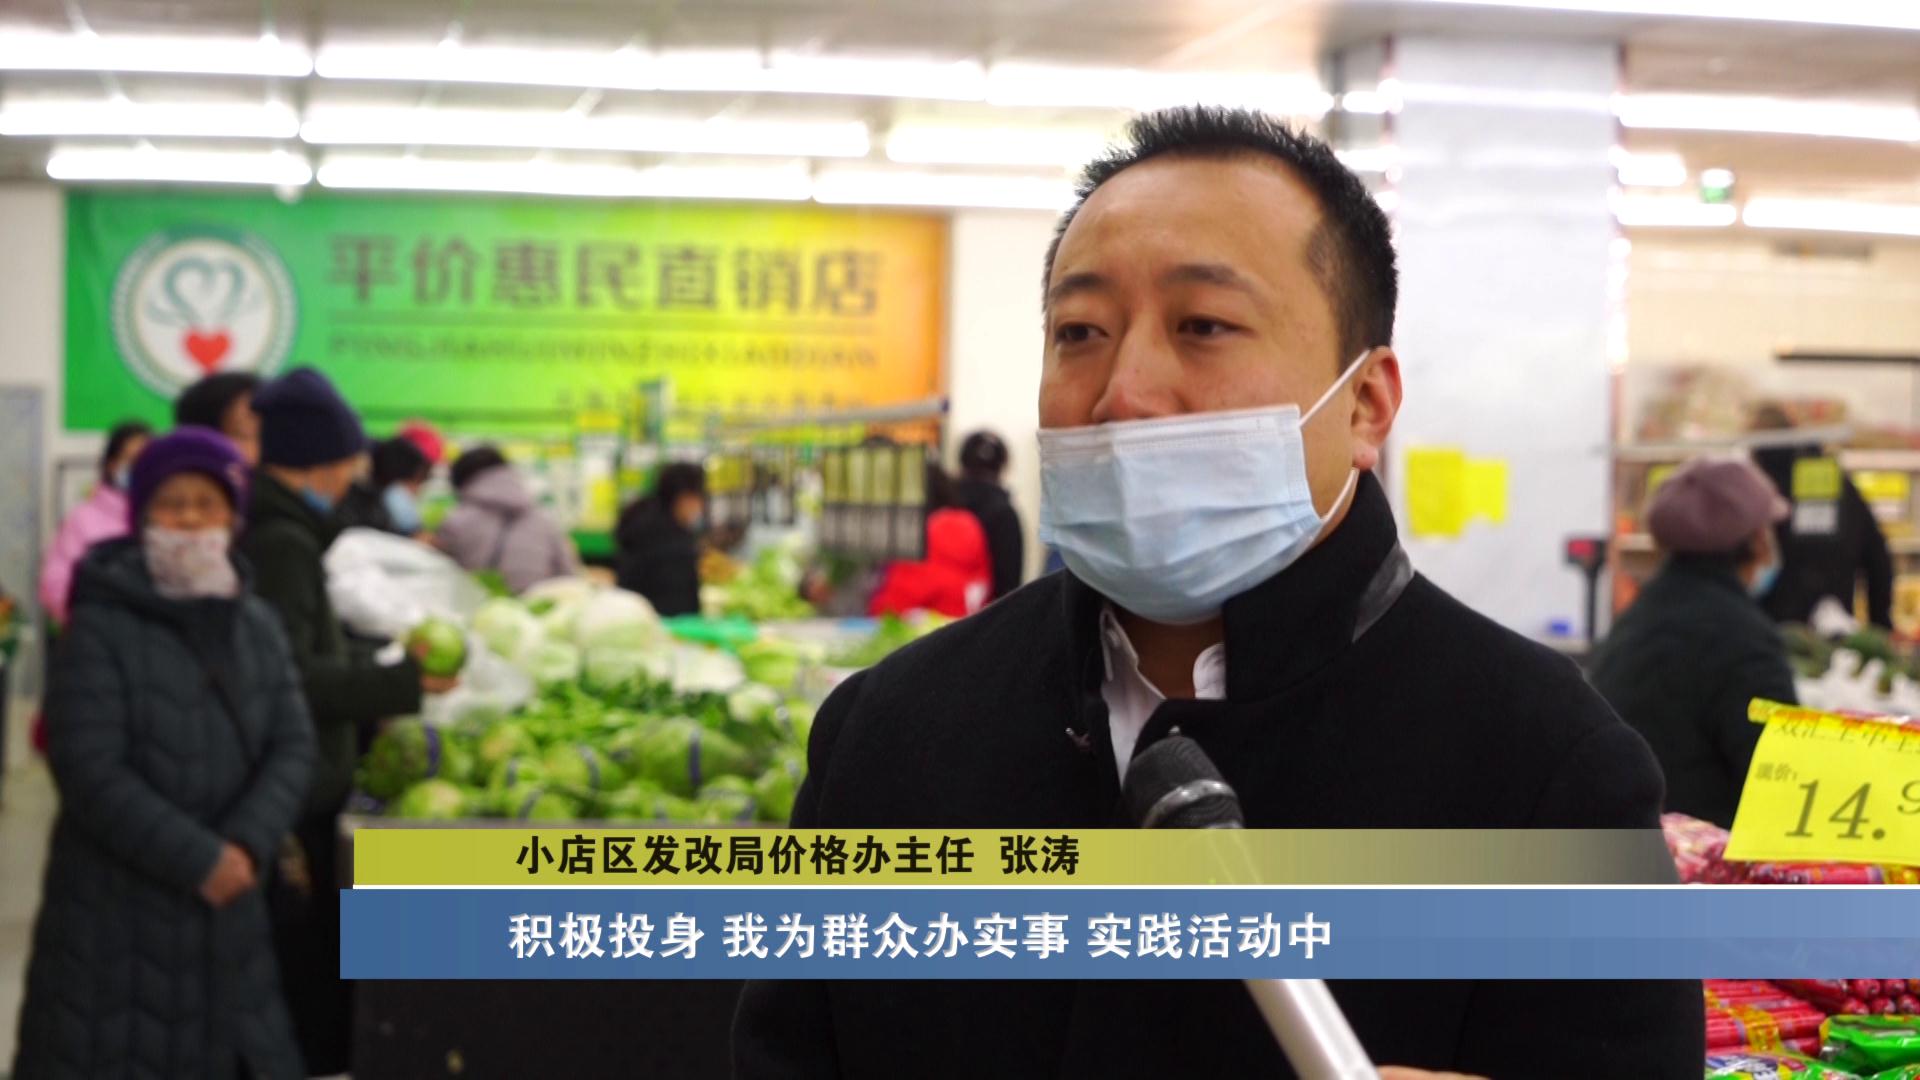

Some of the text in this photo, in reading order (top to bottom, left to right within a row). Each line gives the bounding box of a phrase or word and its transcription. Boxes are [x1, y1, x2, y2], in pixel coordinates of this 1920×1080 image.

[327, 234, 880, 316] 平价惠民直销店
